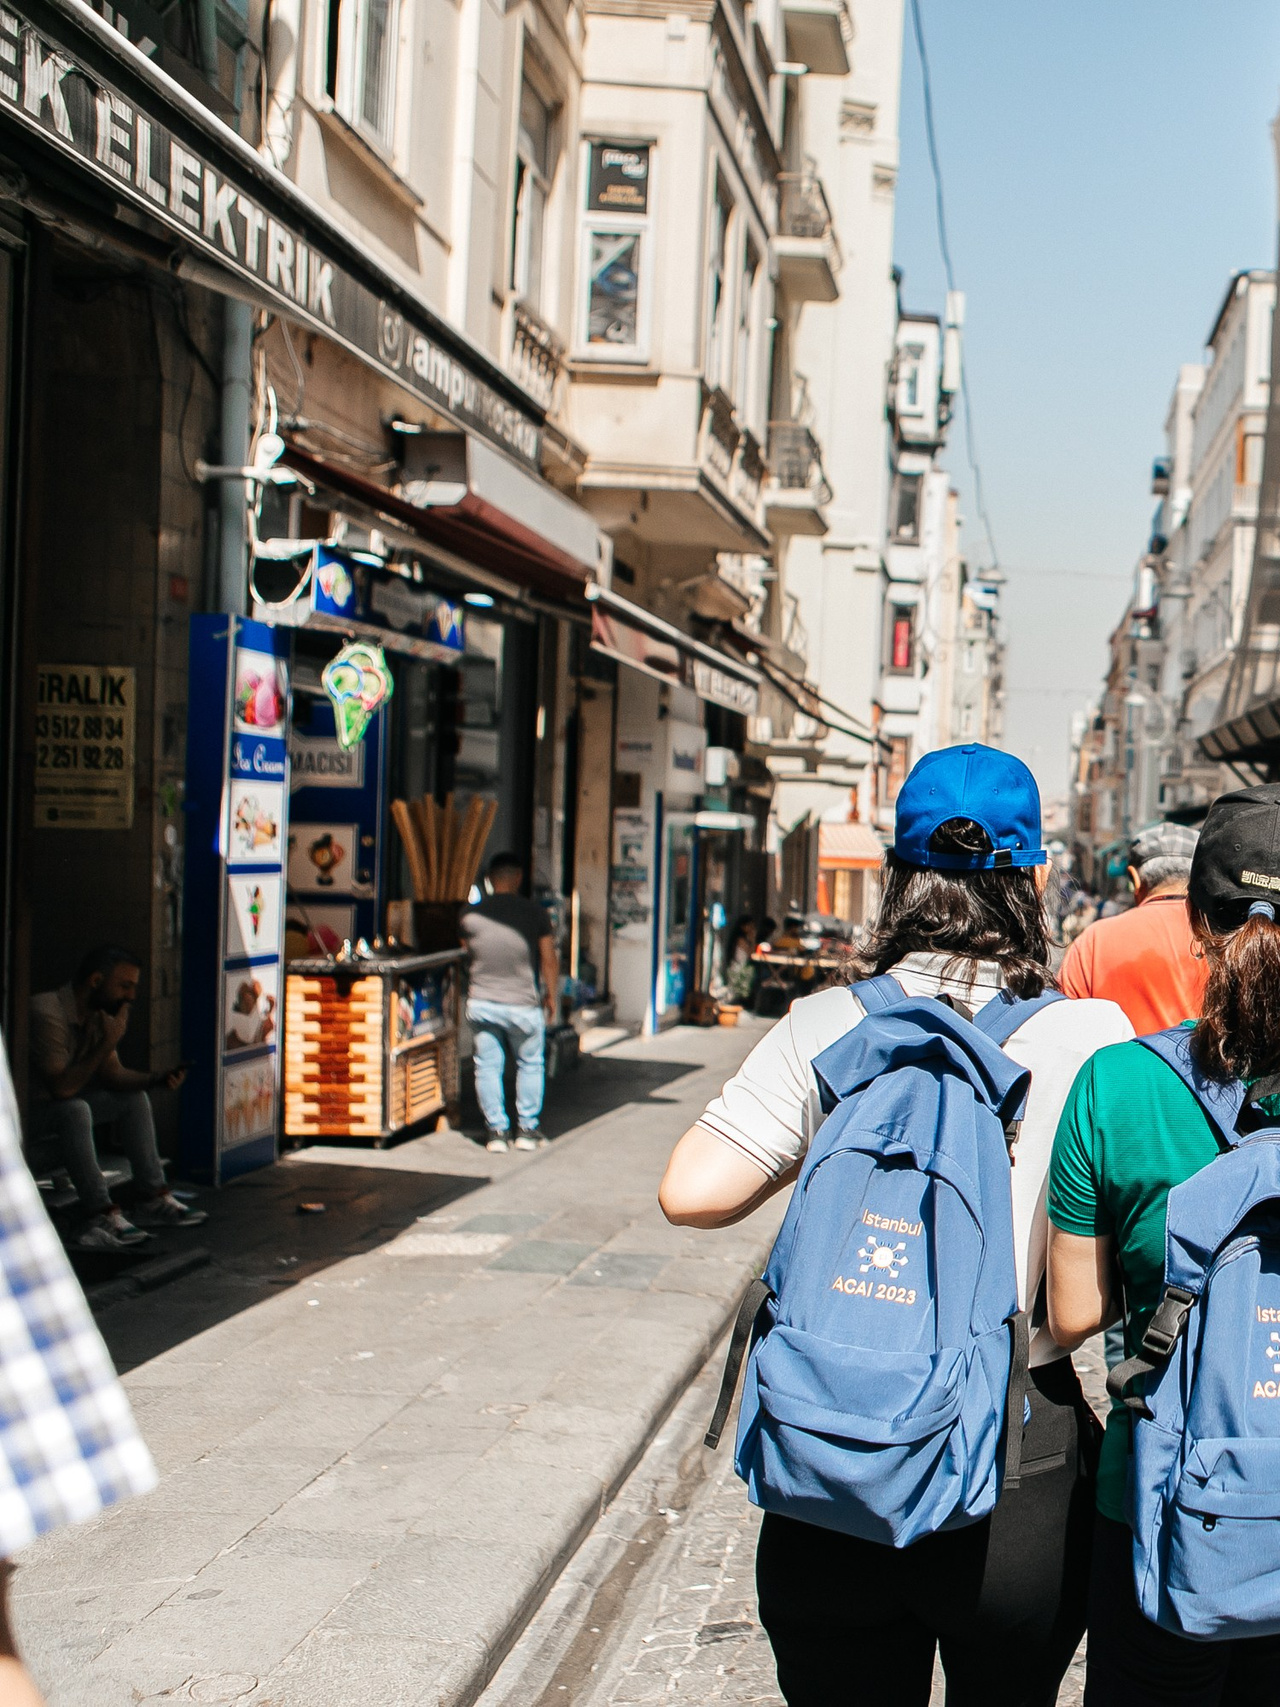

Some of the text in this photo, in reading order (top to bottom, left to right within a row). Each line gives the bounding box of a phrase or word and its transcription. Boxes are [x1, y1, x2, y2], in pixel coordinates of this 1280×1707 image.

[96, 86, 337, 328] ELEKTRIK
[862, 1208, 924, 1237] Istanbul
[831, 1275, 917, 1305] ACAI 2023
